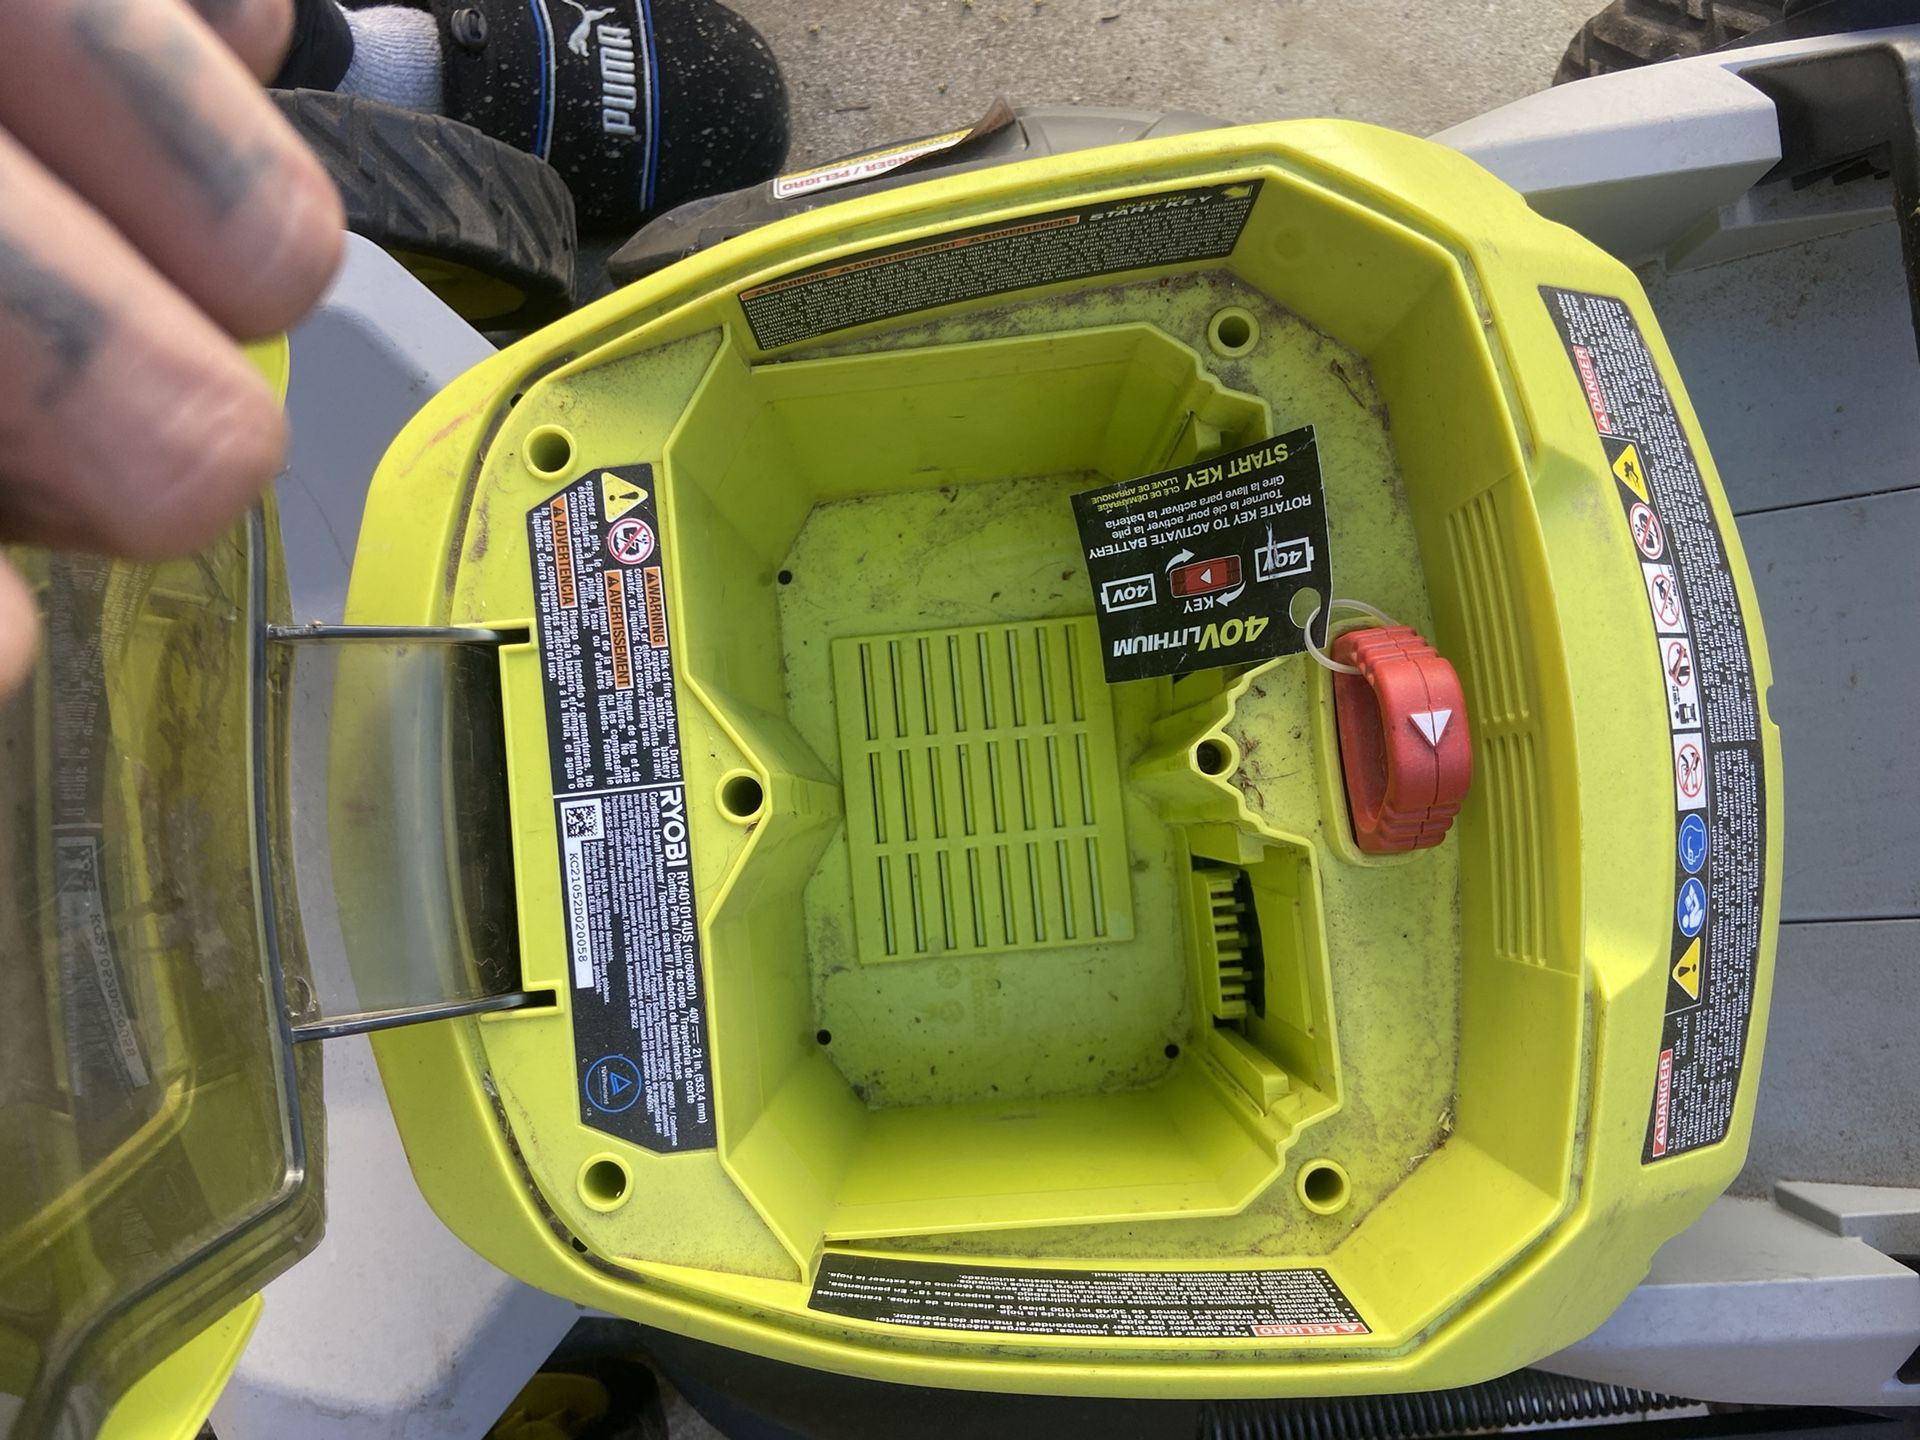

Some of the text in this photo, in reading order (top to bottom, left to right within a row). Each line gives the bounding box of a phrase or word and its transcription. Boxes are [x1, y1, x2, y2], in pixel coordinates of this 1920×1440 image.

[596, 24, 637, 135] PUMA
[783, 170, 850, 191] PELIGRO
[1089, 195, 1212, 222] START KEY
[1576, 348, 1603, 413] DANGER
[1182, 442, 1288, 490] START KEY
[1262, 473, 1284, 489] Gire
[1090, 475, 1177, 506] LLAVE DE ARRANQUE
[1096, 484, 1179, 513] CLÉ DE DÉMARRAGE
[1198, 489, 1222, 504] para
[1225, 484, 1248, 499] llave
[1250, 481, 1259, 492] la
[1111, 488, 1281, 539] Tourner la clé pour activer la pile
[1147, 509, 1157, 520] la
[1159, 498, 1197, 516] activar
[1087, 493, 1311, 560] ROTATE KEY TO ACTIVATE BATTERY
[537, 553, 548, 579] Cierre
[554, 519, 573, 605] ADVERTENCIA
[540, 582, 549, 590] la
[1110, 582, 1149, 603] 40V
[539, 592, 550, 612] tapa
[647, 583, 664, 642] WARNING
[1181, 595, 1213, 613] KEY
[543, 614, 554, 649] durante
[608, 589, 629, 686] AVERTISSEMENT
[1110, 612, 1270, 657] 40V LITHIUM
[547, 651, 555, 660] el
[624, 569, 649, 749] water, or liquids. Close cover during use.
[547, 662, 556, 681] uso.
[633, 568, 662, 779] compartment, or electronic components to rain,
[650, 650, 671, 779] expose battery, battery
[659, 649, 680, 778] Risk of fire and burns. Do not
[620, 743, 629, 755] Ne
[622, 690, 641, 782] Risque de feu et de
[620, 766, 630, 783] pas
[611, 795, 620, 827] Techtronic
[649, 791, 660, 827] Cordless
[652, 829, 662, 852] Lawn
[659, 787, 688, 866] RYOBI
[614, 829, 623, 860] Industries
[607, 848, 620, 913] www.ryobitools.com
[617, 862, 625, 881] Power
[654, 854, 665, 883] Mower
[617, 883, 628, 918] Equipment,
[665, 872, 678, 903] Cutting
[569, 852, 587, 962] KC21052D020058
[658, 890, 670, 930] Tondeuse
[670, 905, 680, 925] Path
[662, 932, 670, 952] sans
[672, 933, 683, 966] Chemin
[664, 954, 673, 962] fil
[675, 968, 685, 979] de
[625, 965, 635, 997] Anderson,
[665, 970, 677, 1009] Podadora
[675, 981, 686, 1007] coupe
[629, 998, 636, 1007] SC
[676, 871, 707, 1123] RY401014US (107608001) 40V 21 in. (533,4 mm)
[669, 1011, 678, 1022] de
[678, 1016, 692, 1064] Trayectoria
[684, 1067, 693, 1078] de
[1668, 1138, 1674, 1150] To
[1677, 1017, 1682, 1028] of
[685, 1080, 695, 1103] corte
[1656, 1057, 1670, 1128] DANGER
[1687, 1091, 1696, 1136] Operator
[1260, 1325, 1334, 1334] PELIGRO
